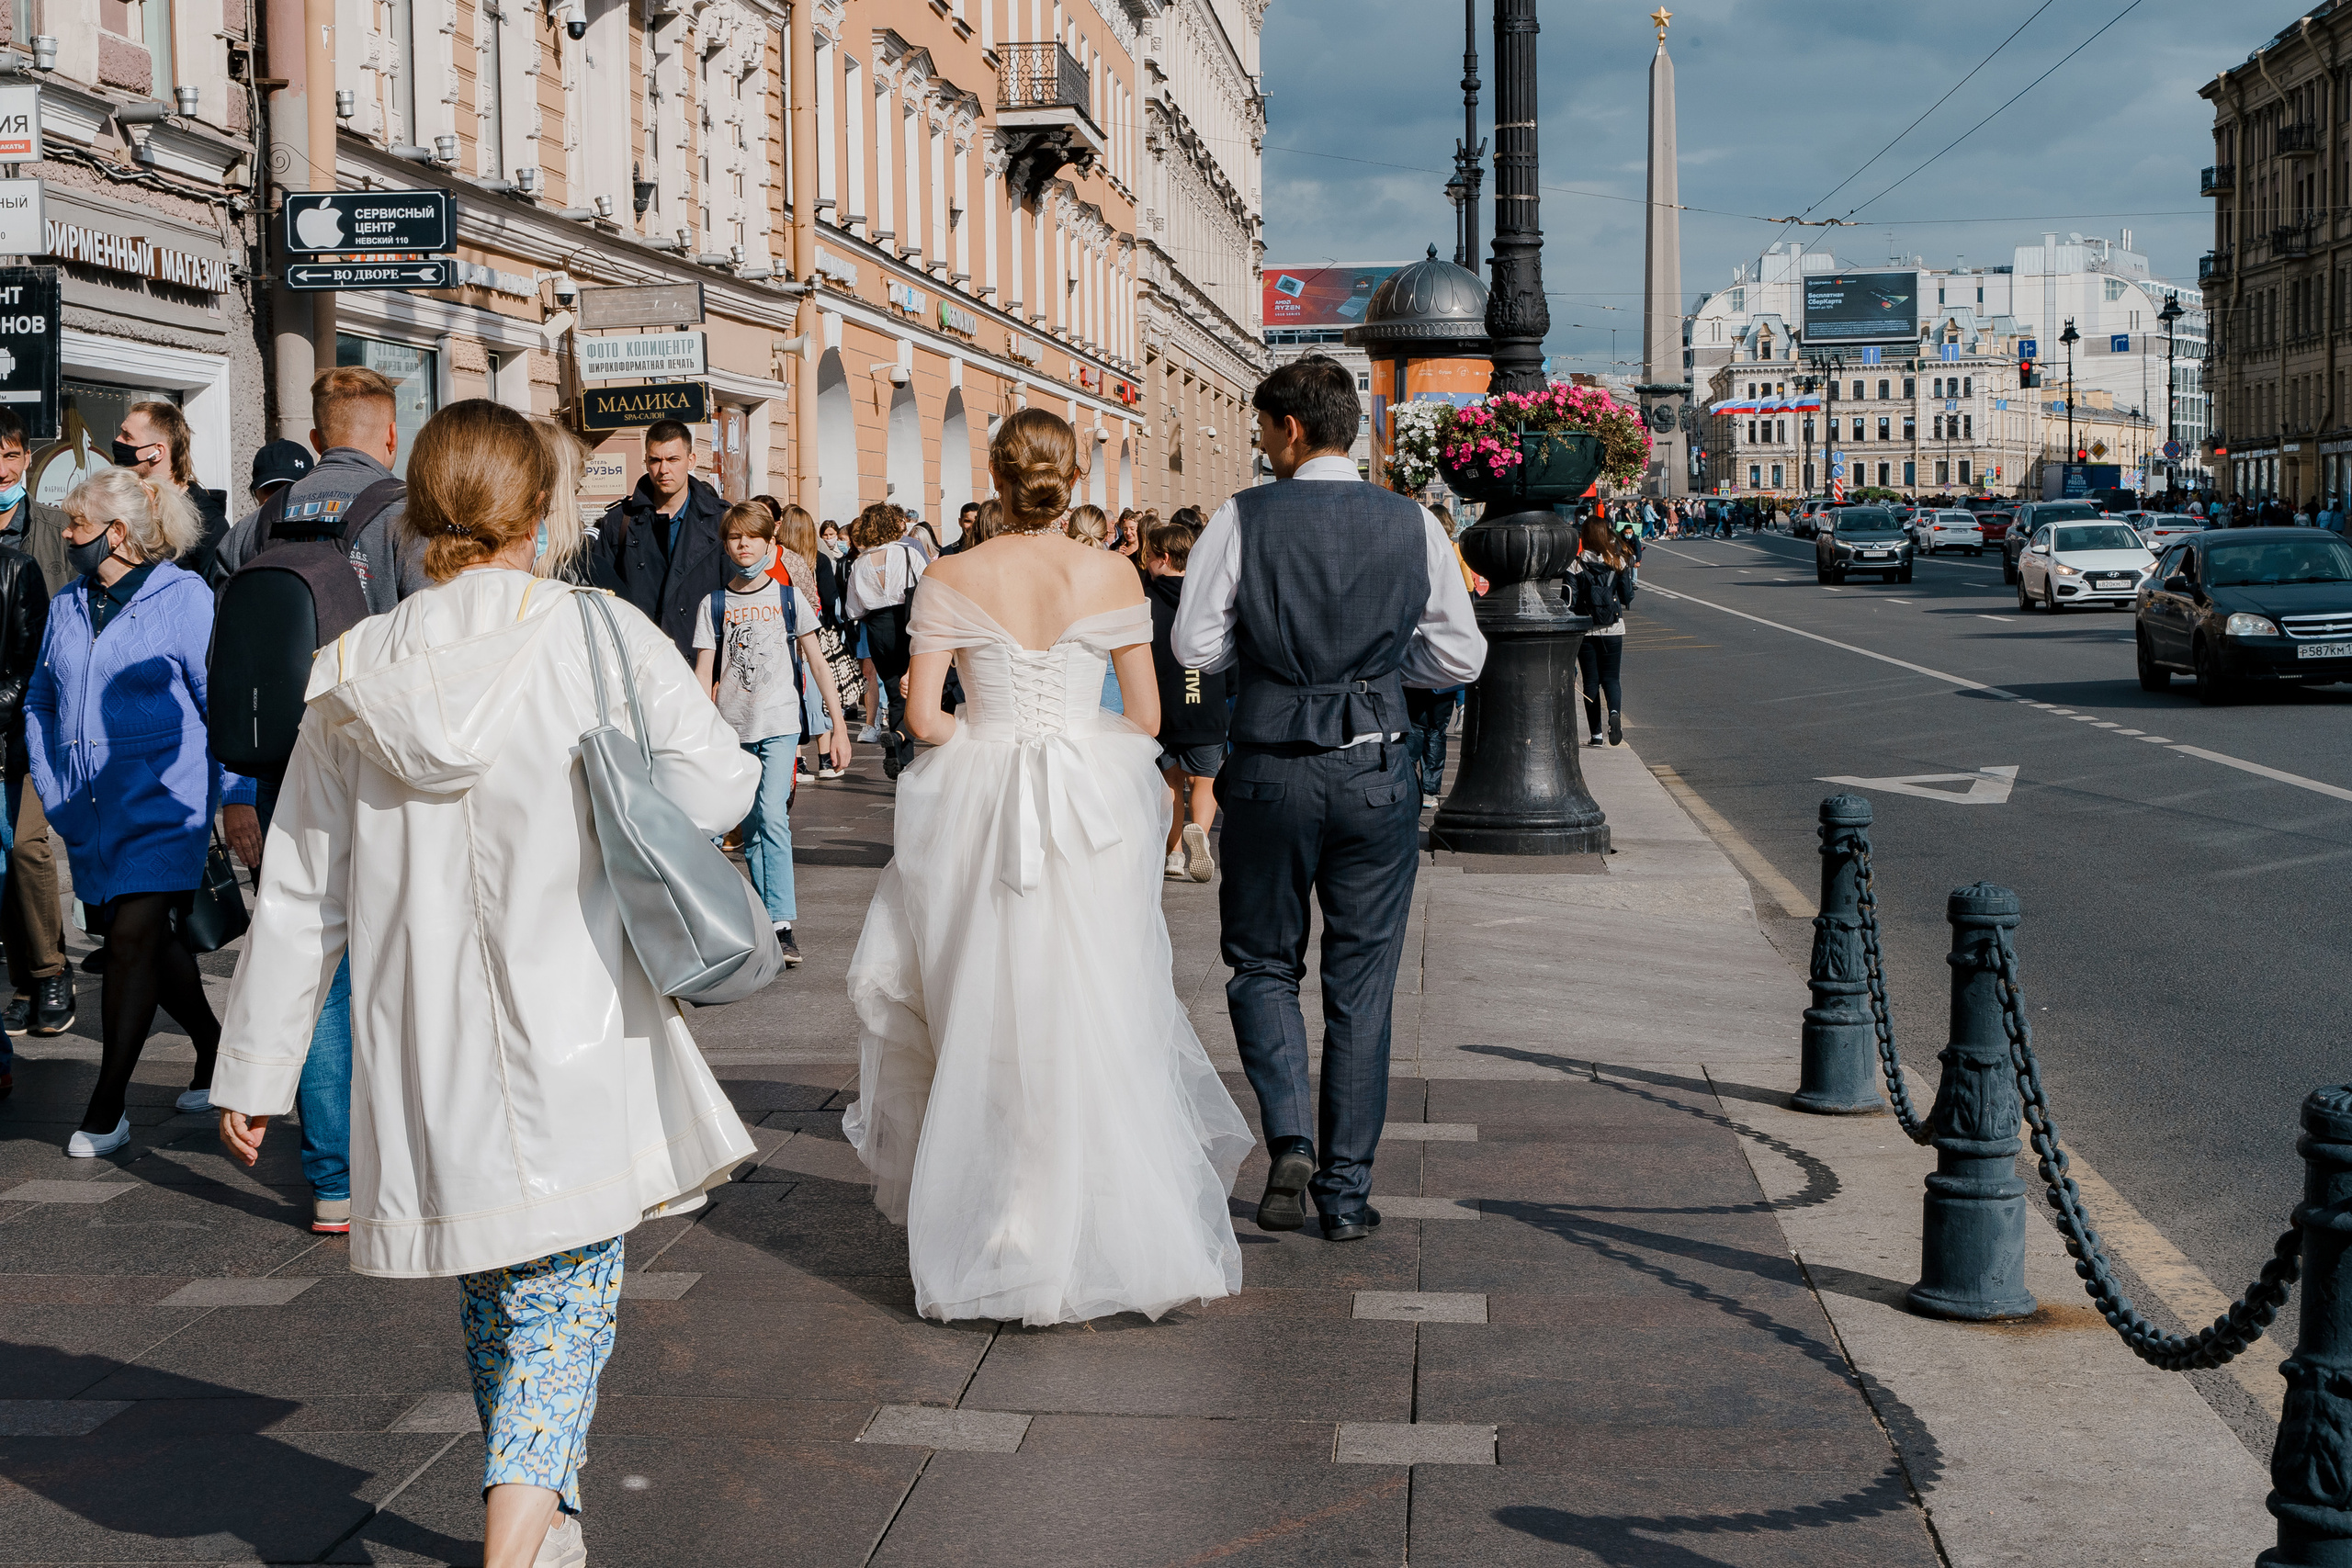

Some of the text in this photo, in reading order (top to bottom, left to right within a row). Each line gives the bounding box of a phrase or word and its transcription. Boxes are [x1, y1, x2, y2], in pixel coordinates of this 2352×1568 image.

[355, 205, 435, 220] СЕРВИСНЫЙ
[355, 222, 396, 235] ЦЕНТР
[355, 235, 409, 244] НЕВСКИЙ 110
[161, 247, 231, 294] МАГАЗИН
[333, 268, 400, 282] ВО ДВОРЕ
[586, 338, 695, 359] ФОТО КОПИЦЕНТР
[588, 358, 695, 374] ШИРОКОФОРМАТНАЯ ПЕЧАТЬ
[597, 391, 691, 413] МАЛИКА
[624, 412, 665, 421] SPA-САЛОН
[585, 466, 623, 475] РУЗЬЯ
[316, 491, 352, 501] AVIATION
[724, 604, 784, 626] REEDOM
